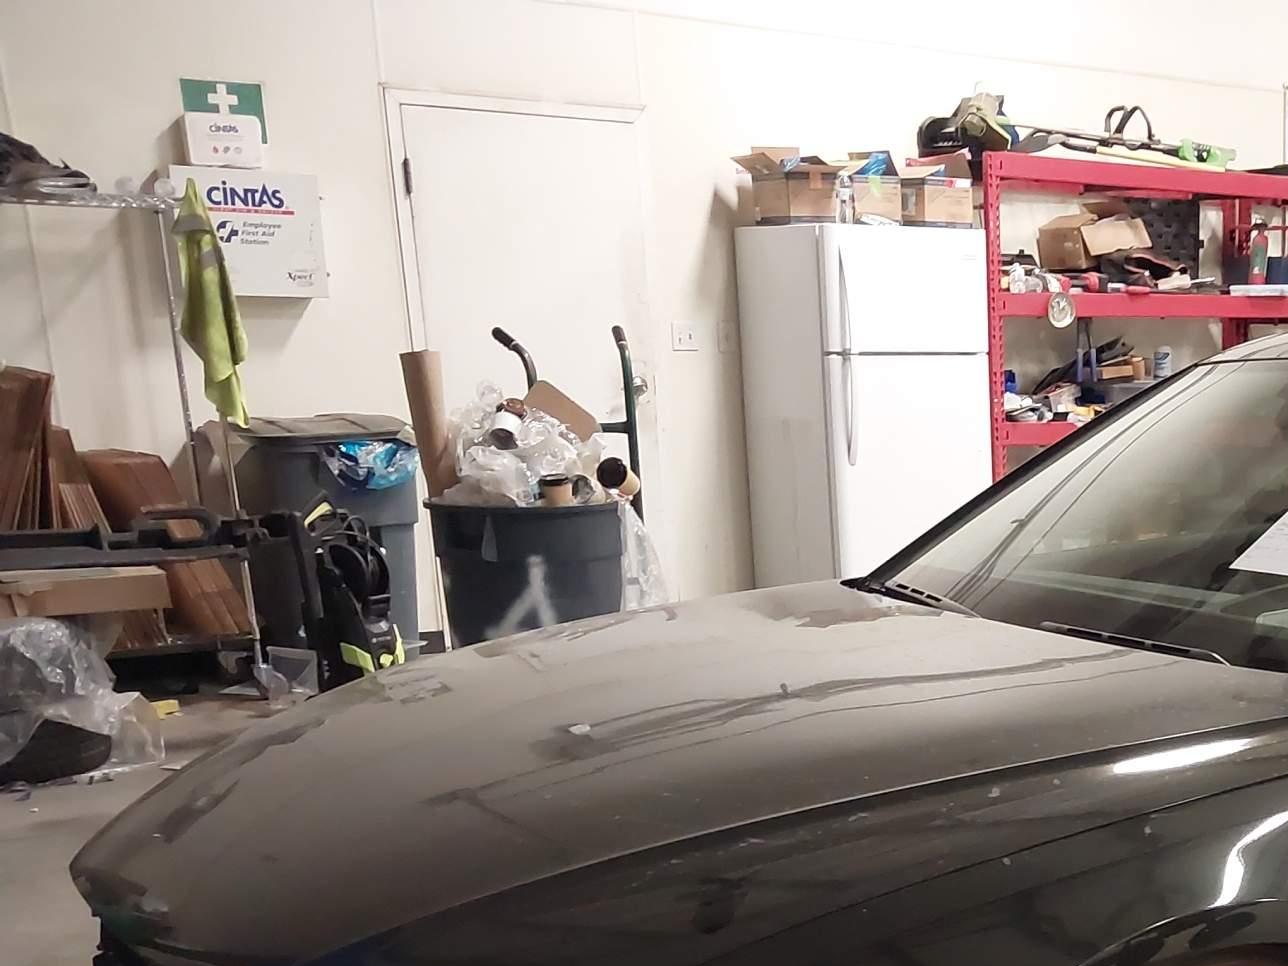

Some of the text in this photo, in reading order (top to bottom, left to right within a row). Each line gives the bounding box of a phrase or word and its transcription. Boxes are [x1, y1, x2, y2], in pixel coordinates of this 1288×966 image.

[242, 221, 281, 231] Employee
[241, 229, 275, 238] First Aid
[240, 237, 270, 245] Station
